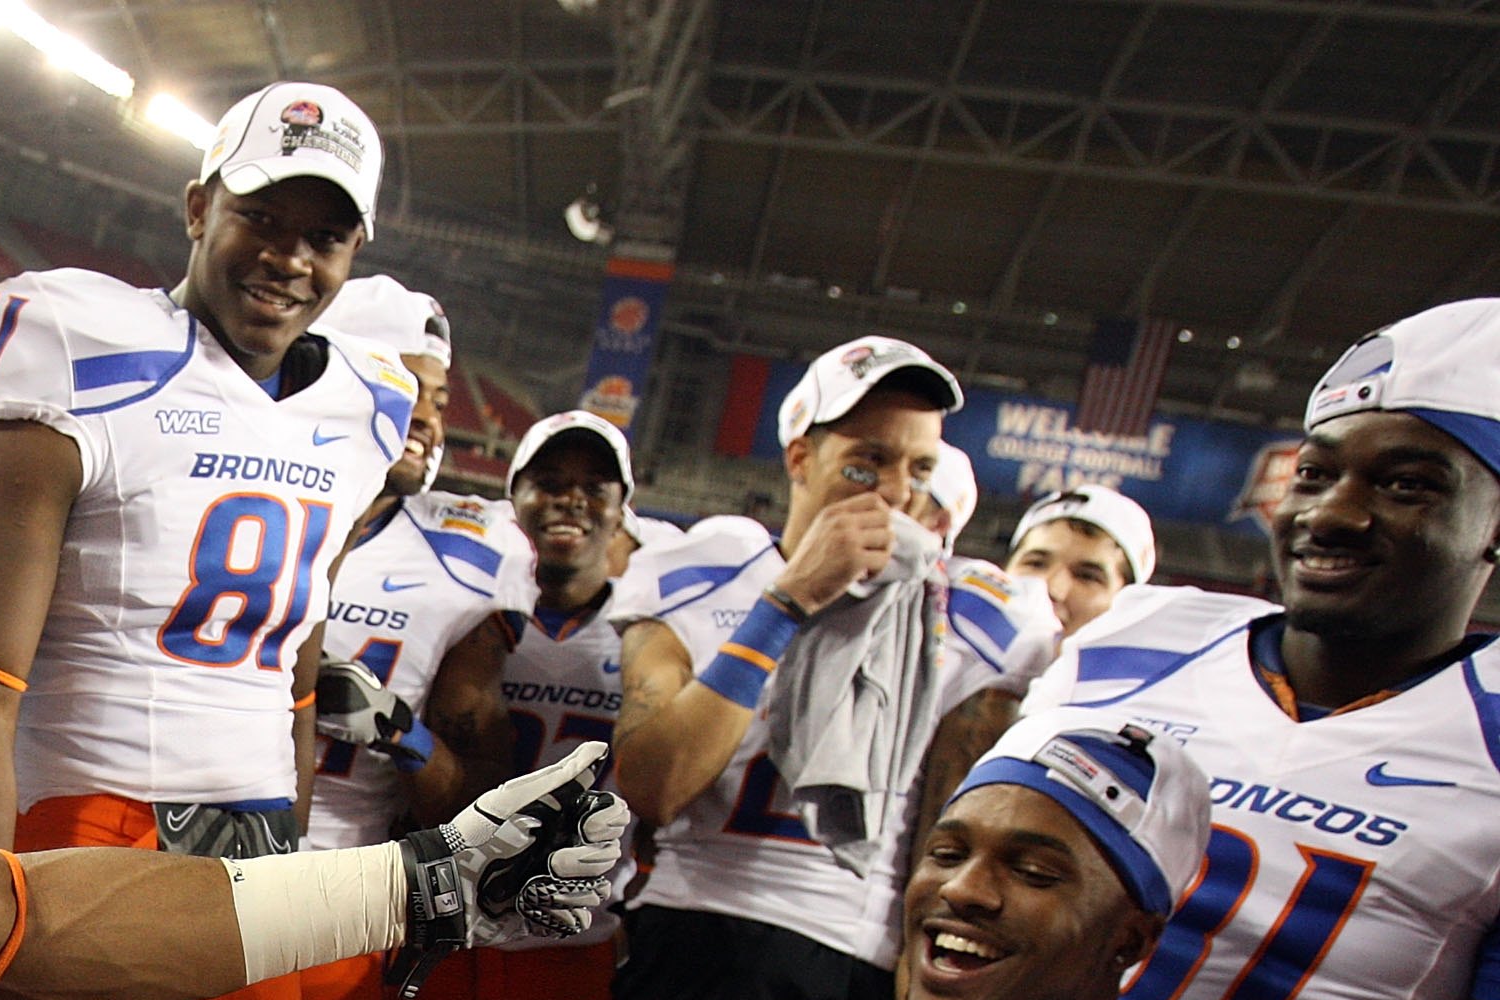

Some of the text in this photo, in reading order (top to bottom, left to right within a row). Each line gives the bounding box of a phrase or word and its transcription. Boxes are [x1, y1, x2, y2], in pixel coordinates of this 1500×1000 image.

[155, 409, 221, 434] WAC
[188, 452, 336, 493] BRONCOS
[155, 491, 334, 673] 81
[502, 680, 622, 712] RONCOS
[1209, 776, 1408, 846] ONCOS
